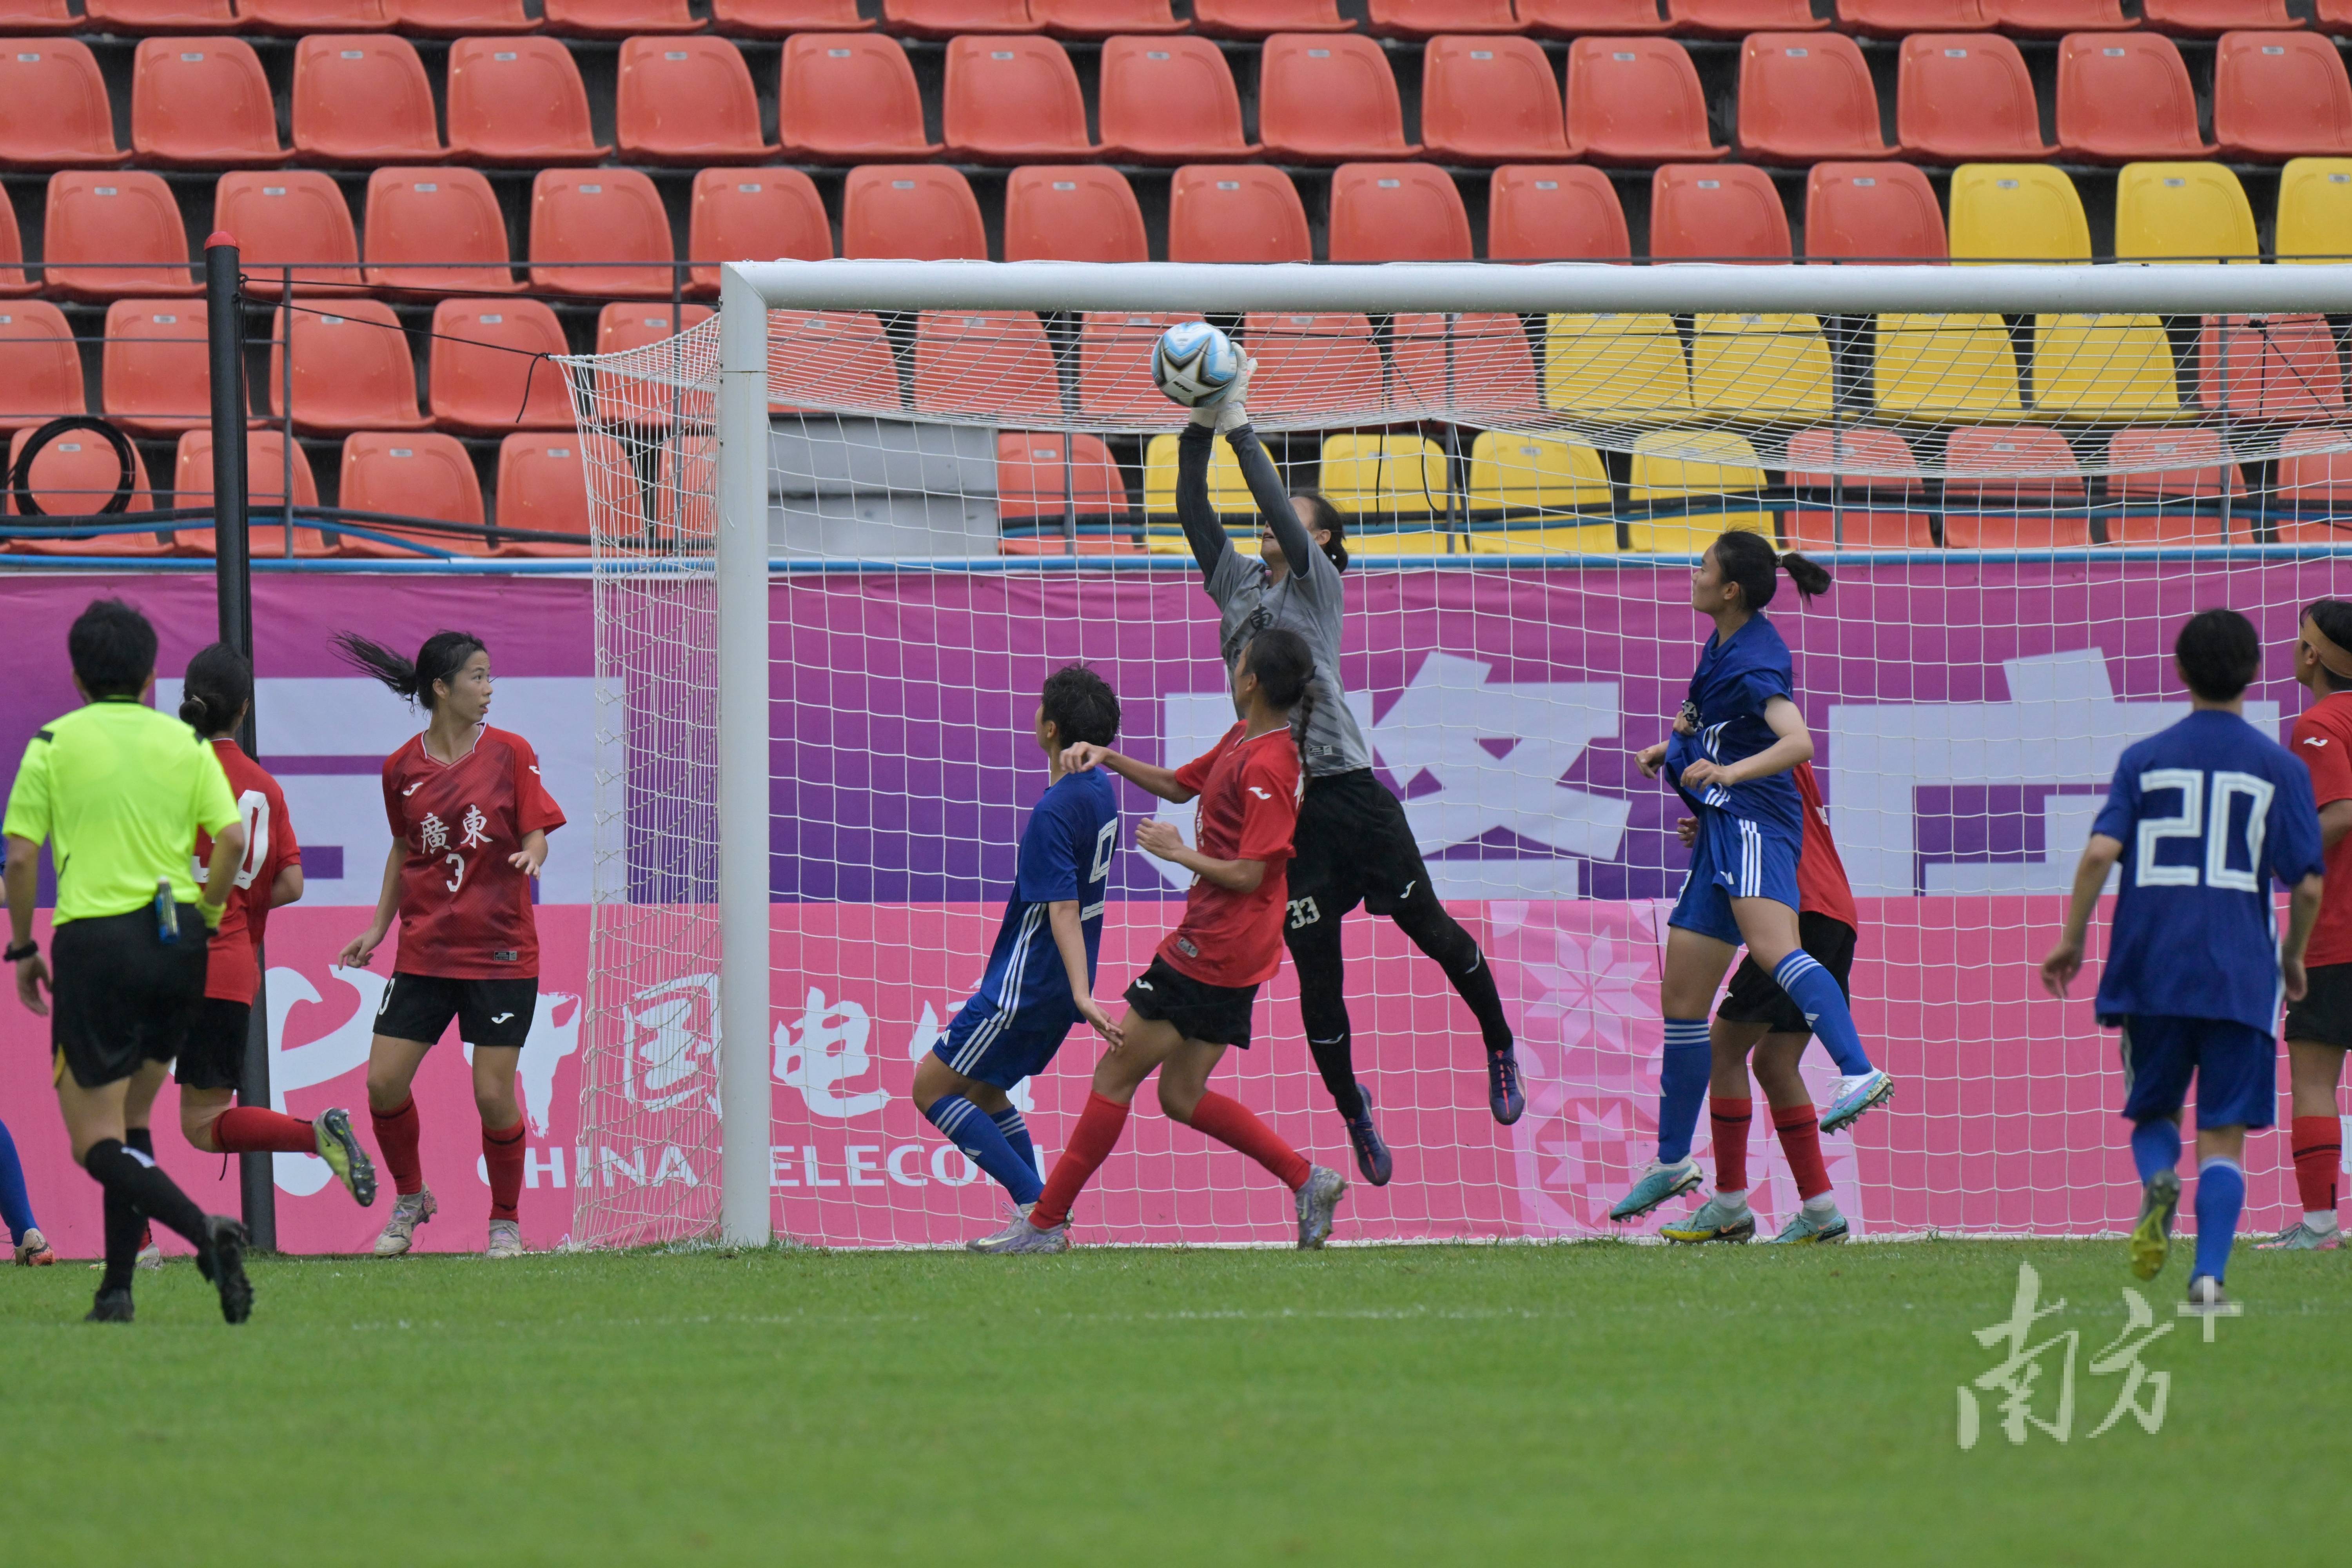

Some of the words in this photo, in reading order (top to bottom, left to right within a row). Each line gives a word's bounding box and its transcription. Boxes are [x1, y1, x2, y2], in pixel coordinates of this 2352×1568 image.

[420, 804, 493, 854] 廣東
[2136, 768, 2275, 893] 20
[446, 853, 465, 892] 3
[1285, 896, 1321, 929] 33
